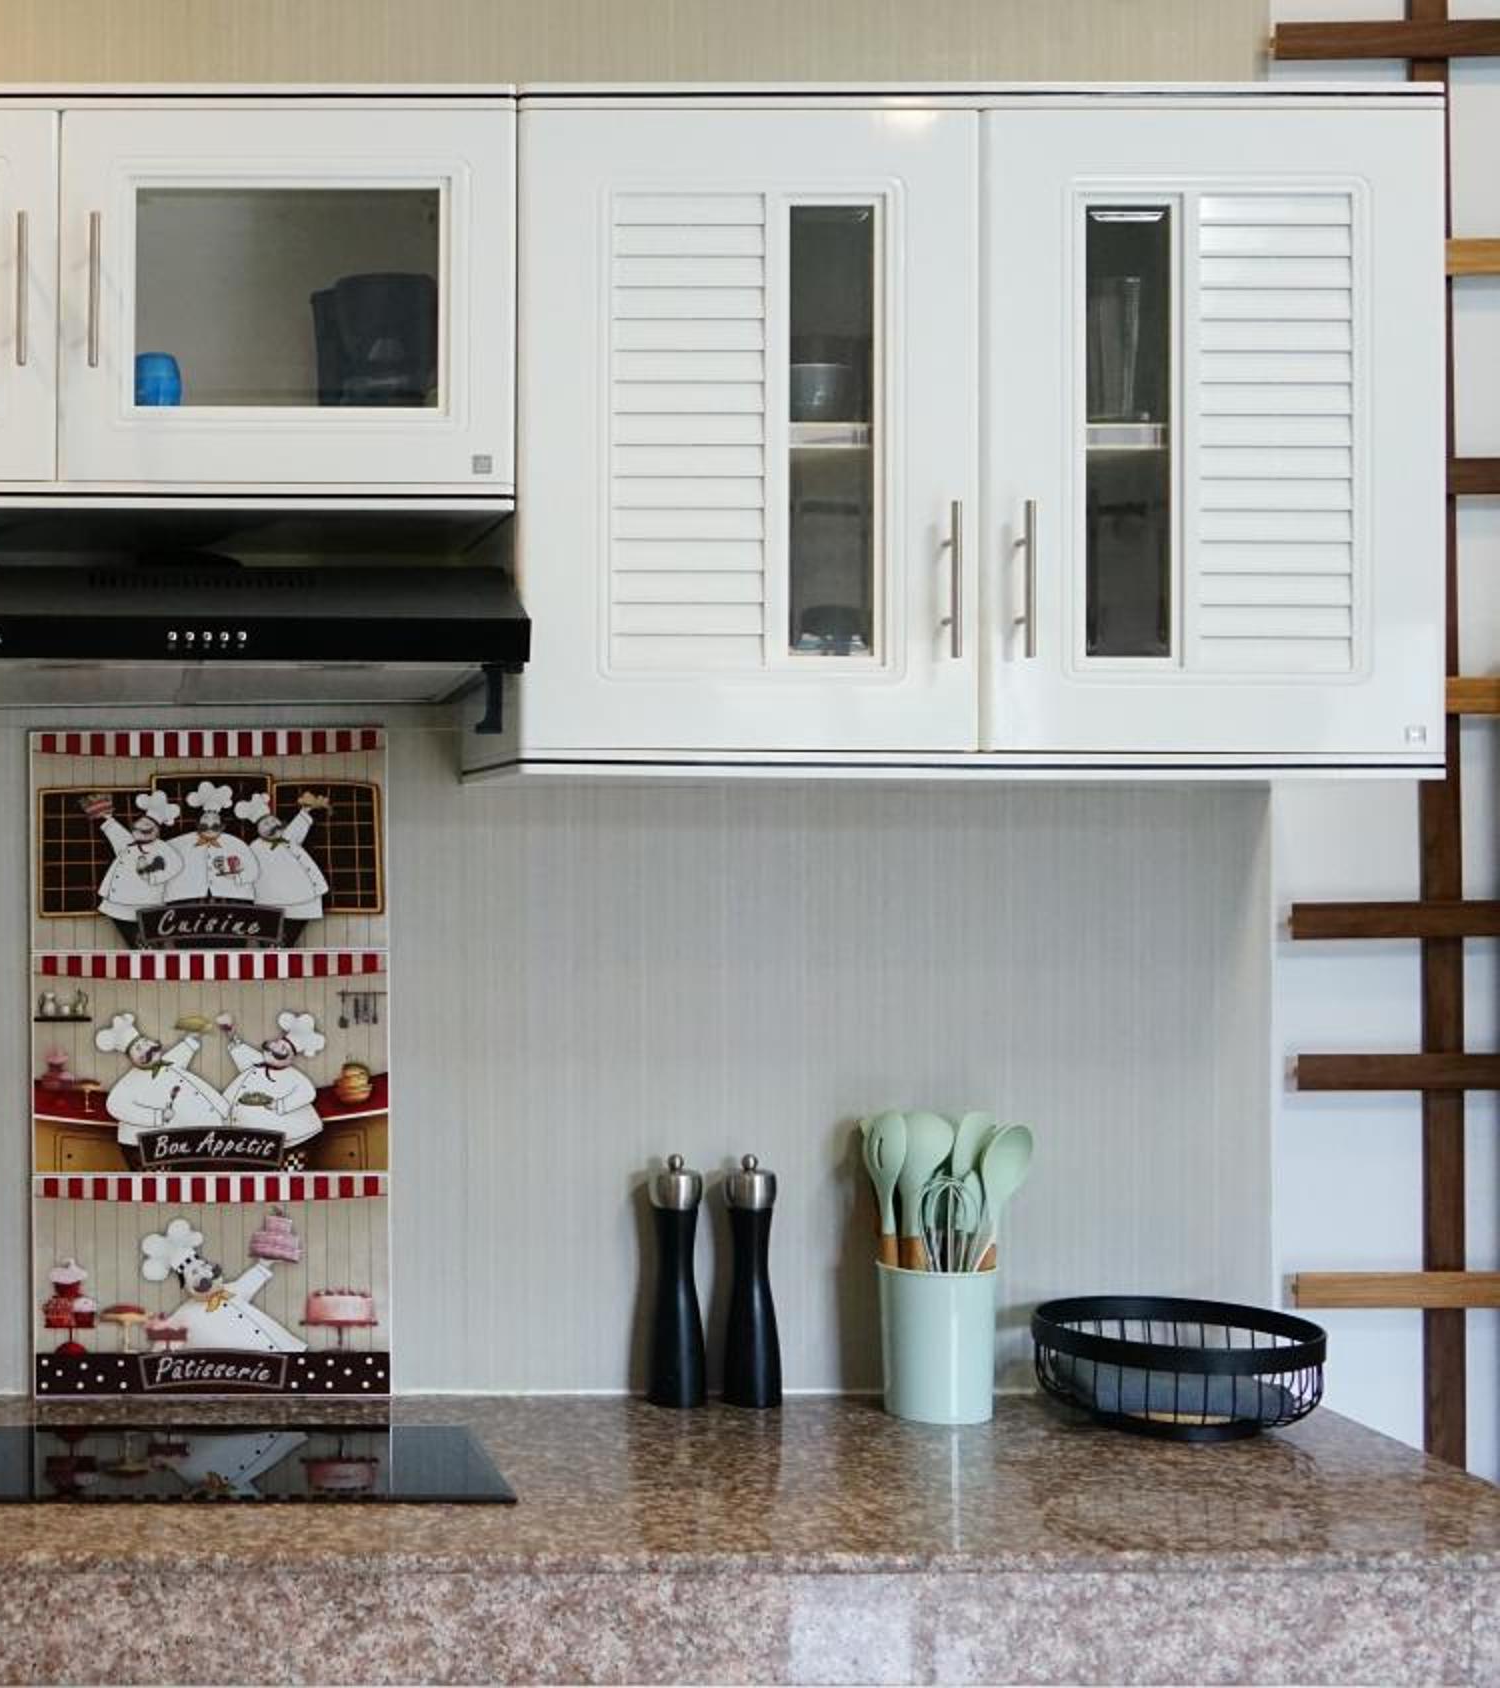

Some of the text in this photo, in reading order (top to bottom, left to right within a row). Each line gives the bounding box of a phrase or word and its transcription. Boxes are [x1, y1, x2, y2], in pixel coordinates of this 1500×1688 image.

[157, 908, 261, 936] Cuisine
[155, 1134, 191, 1159] Bon
[155, 1355, 272, 1383] Pâtisserie
